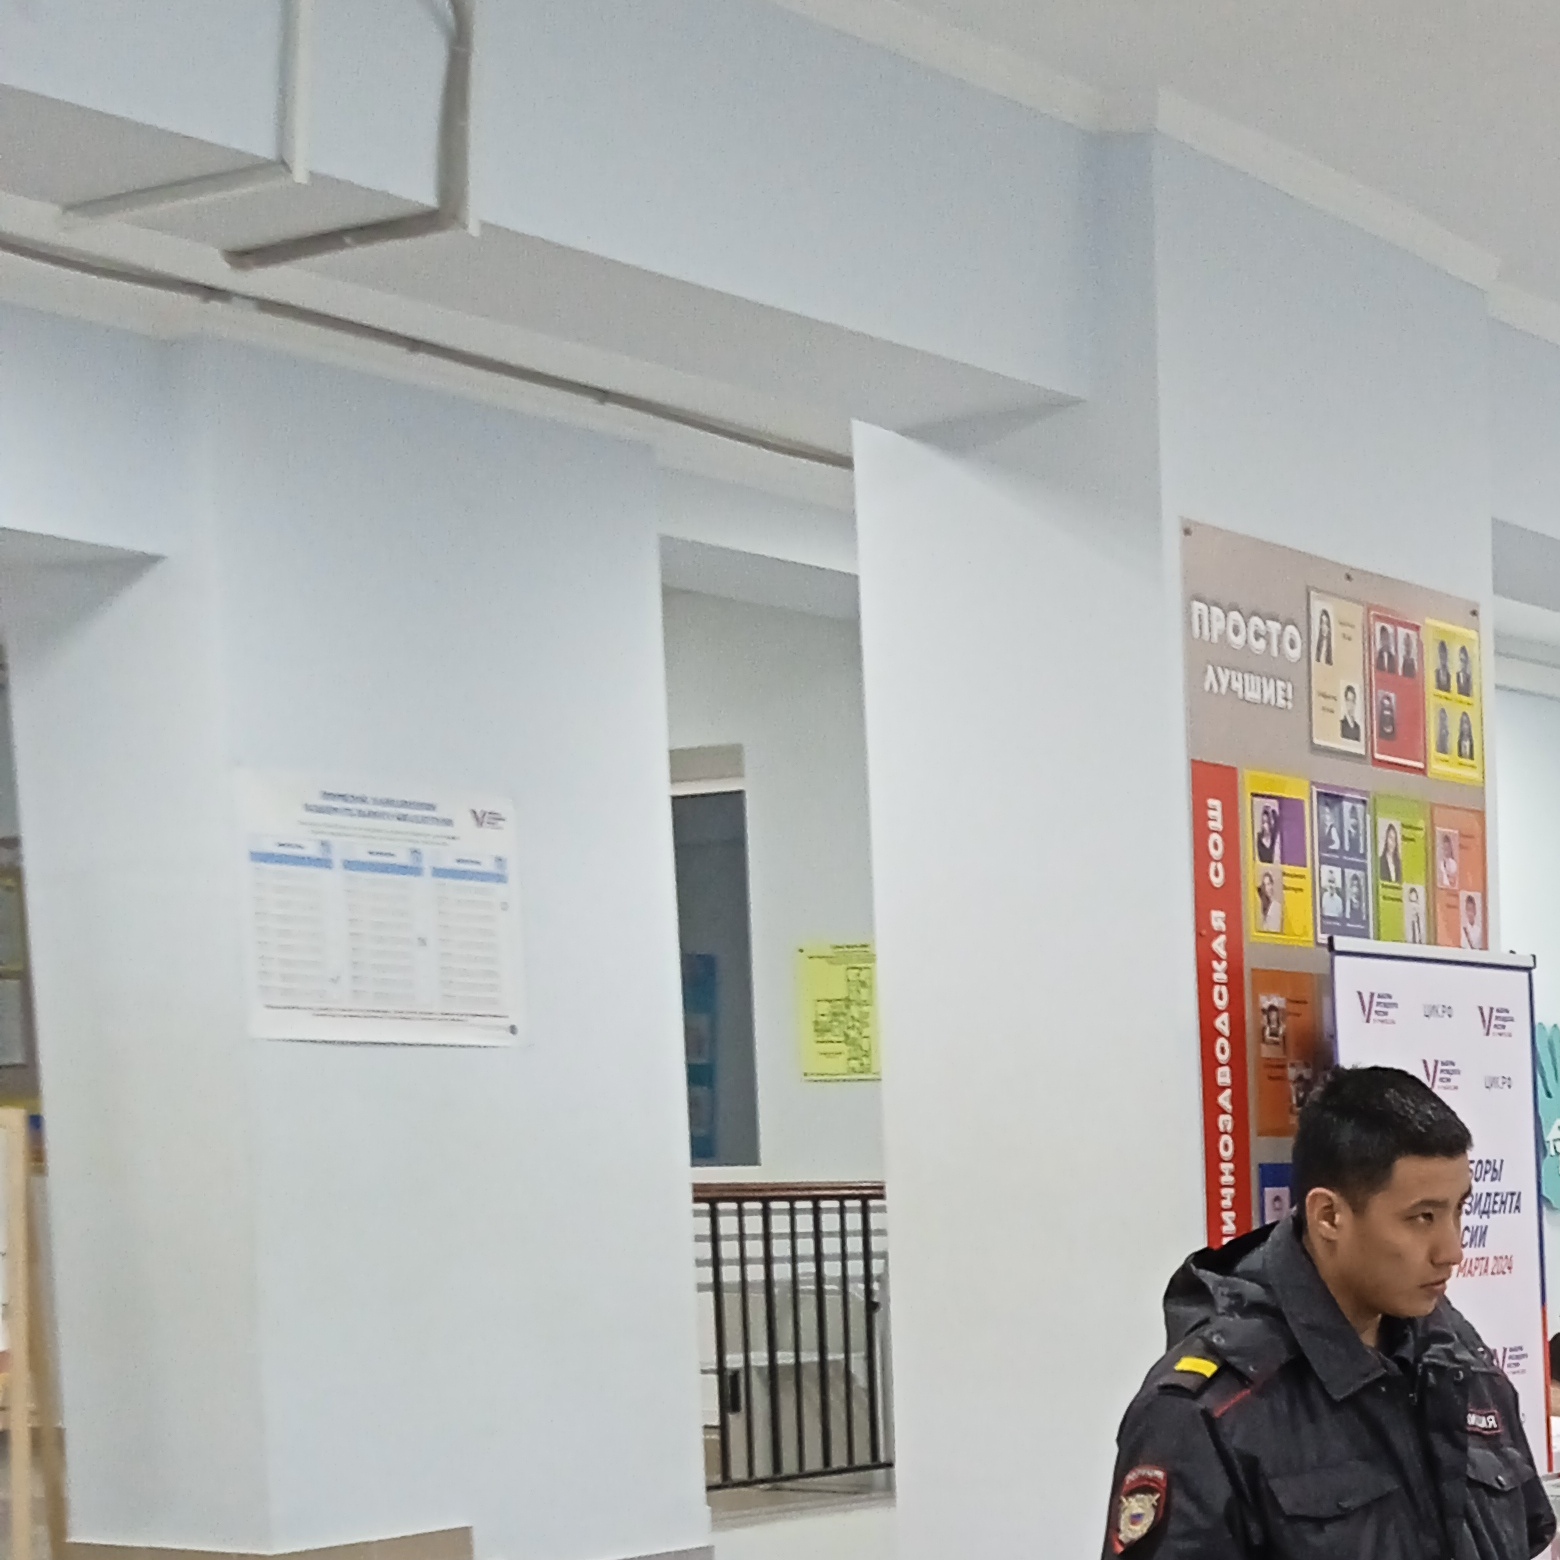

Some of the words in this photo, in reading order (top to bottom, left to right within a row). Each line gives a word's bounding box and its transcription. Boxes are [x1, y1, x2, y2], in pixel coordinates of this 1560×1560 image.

[1191, 600, 1302, 663] ПРОСТО
[1203, 665, 1293, 710] ЛУЧШИЕ!
[1207, 798, 1225, 888] СОШ
